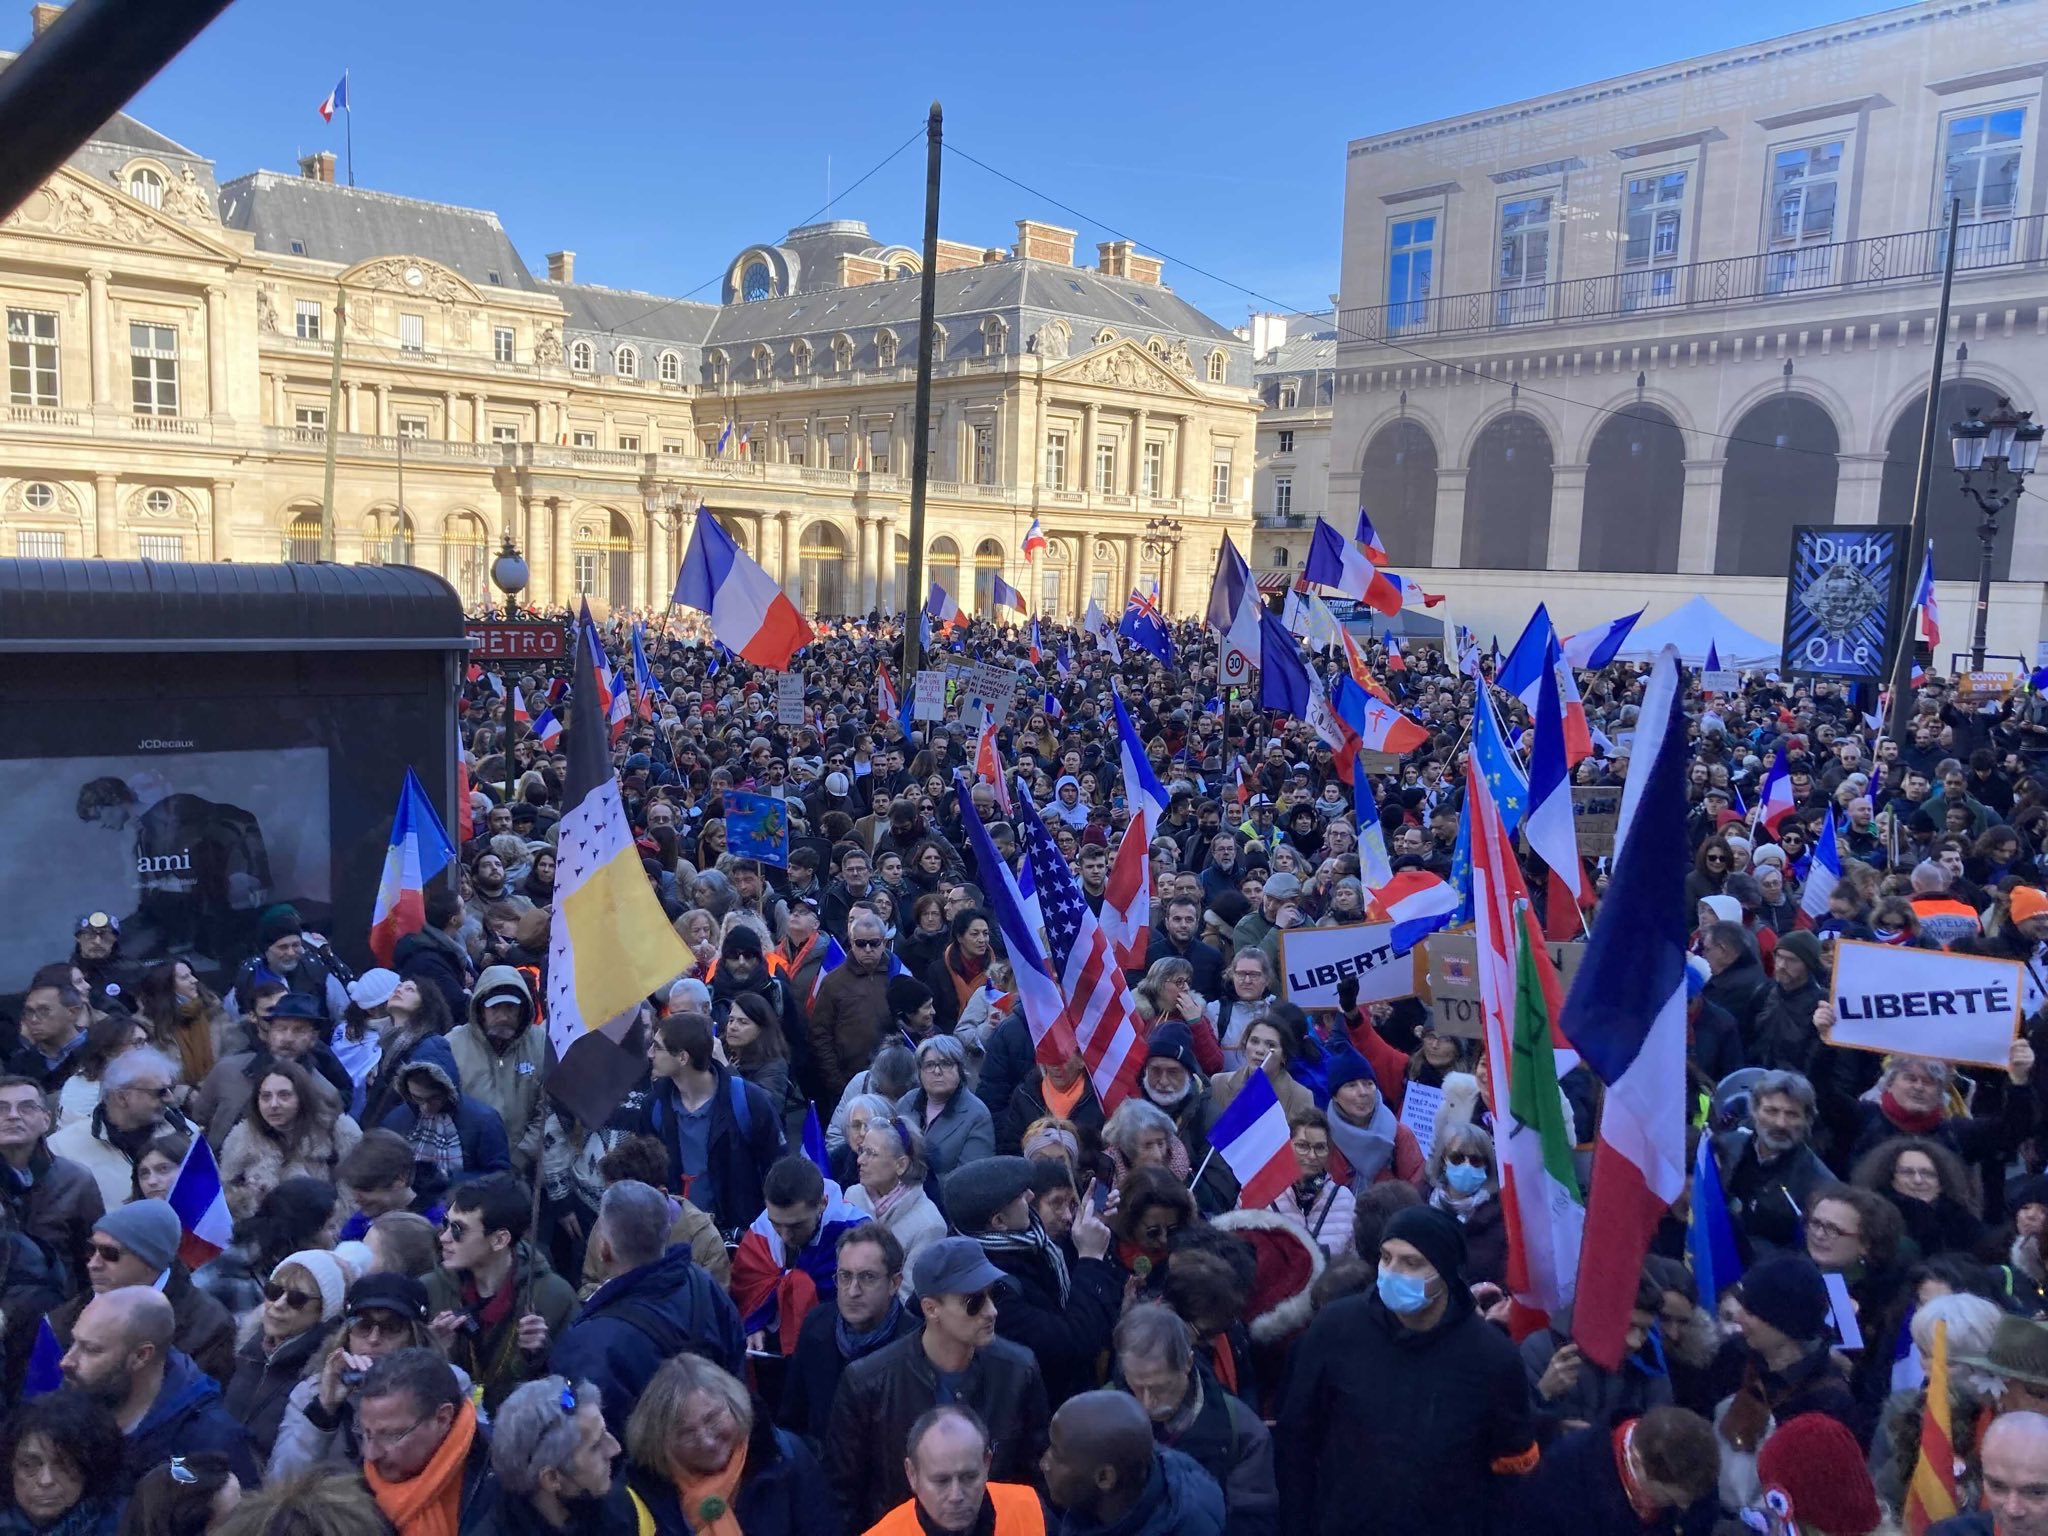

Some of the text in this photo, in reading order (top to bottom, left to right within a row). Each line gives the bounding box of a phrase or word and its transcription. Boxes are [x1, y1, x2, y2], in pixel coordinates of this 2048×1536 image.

[1814, 537, 1882, 564] Dinh
[468, 630, 557, 653] METRO
[1805, 636, 1869, 667] Q.Lê
[1229, 657, 1241, 669] 30
[1968, 672, 2008, 682] CONVOI
[1972, 683, 2003, 691] DE LA
[137, 739, 195, 750] JCDecaux
[136, 848, 192, 873] ami
[1838, 979, 2012, 1020] LIBERTÉ
